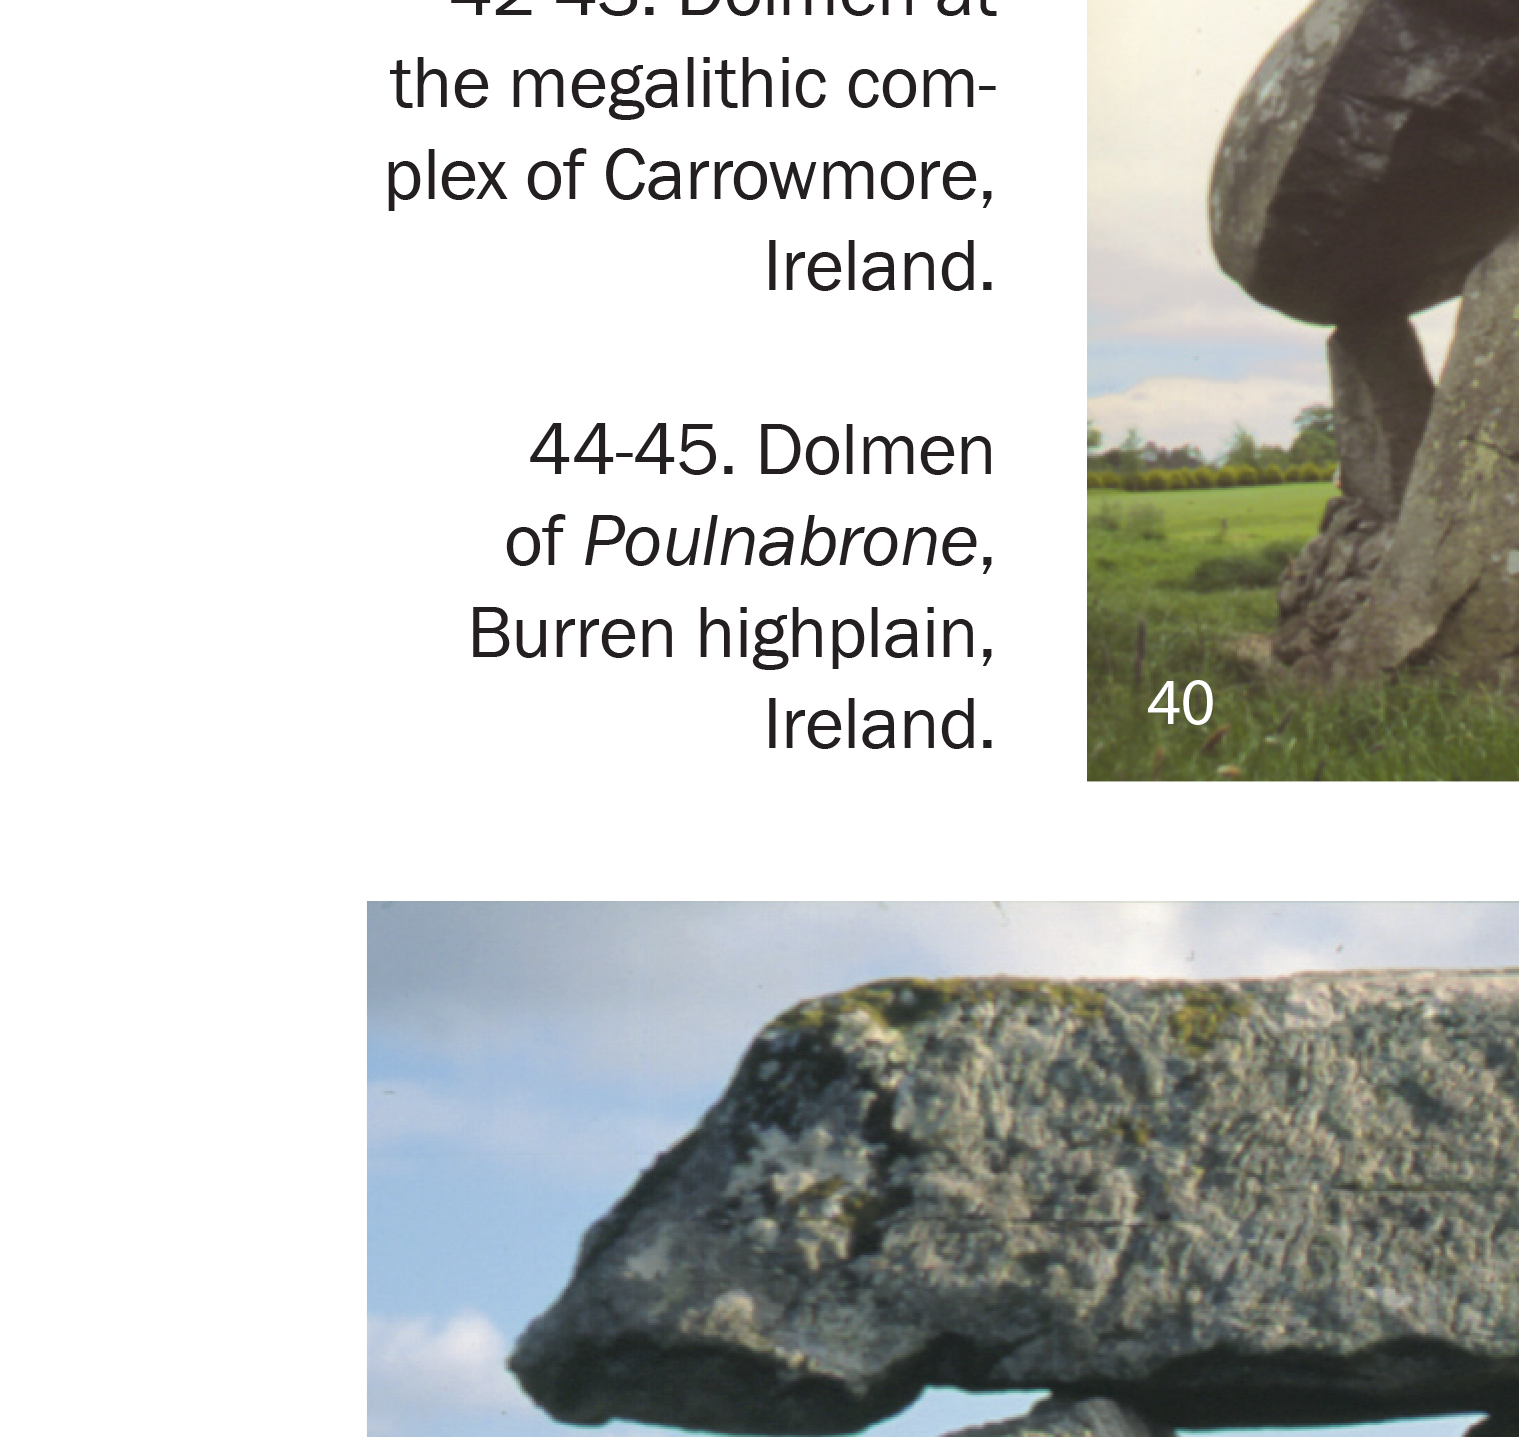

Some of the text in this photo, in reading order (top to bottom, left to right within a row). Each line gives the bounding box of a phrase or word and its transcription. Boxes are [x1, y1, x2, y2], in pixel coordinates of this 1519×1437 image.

[390, 57, 996, 120] the megalithic com-
[389, 148, 992, 211] plex of Carrowmore,
[769, 240, 992, 291] Ireland.
[530, 423, 991, 475] 44-45. Dolmen
[507, 514, 992, 574] of Poulnabrone,
[473, 607, 992, 670] Burren highplain,
[769, 698, 992, 749] Ireland.
